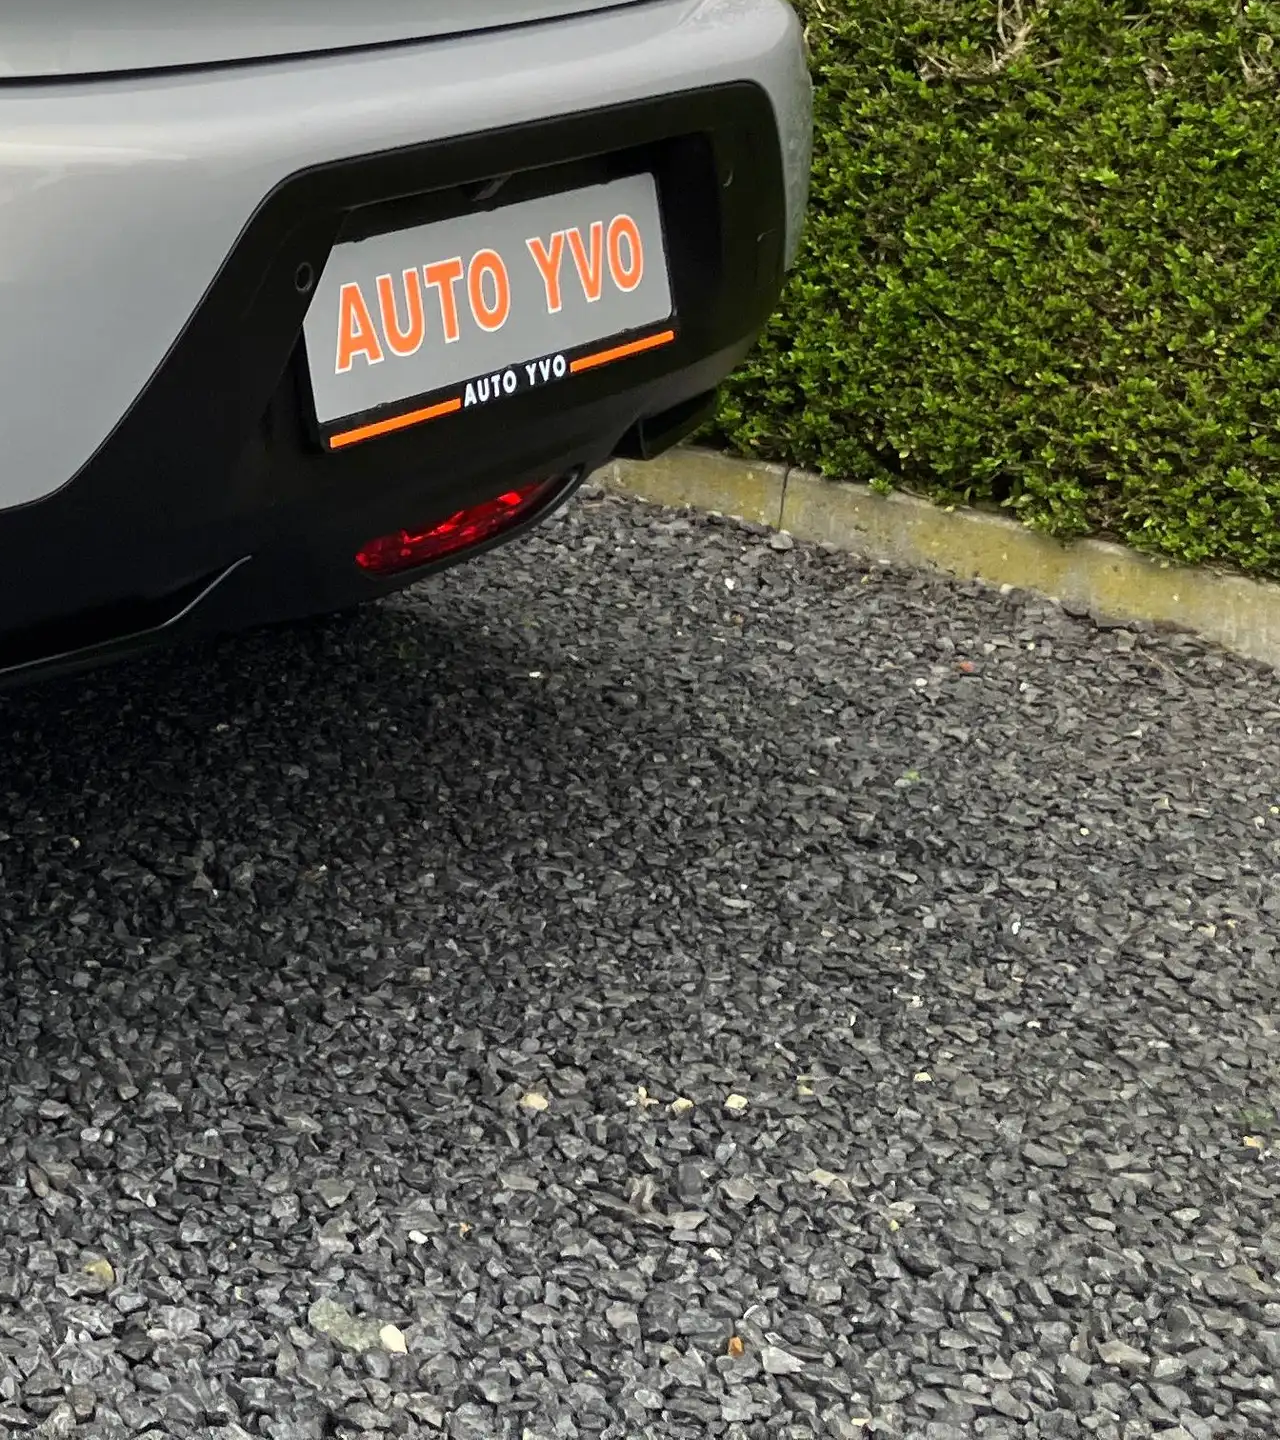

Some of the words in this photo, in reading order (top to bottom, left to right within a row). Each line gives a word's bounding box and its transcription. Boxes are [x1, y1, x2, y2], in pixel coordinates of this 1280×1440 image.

[335, 248, 511, 375] AUTO
[526, 214, 644, 314] YVO
[464, 371, 517, 408] AUTO
[525, 355, 566, 387] YVO
